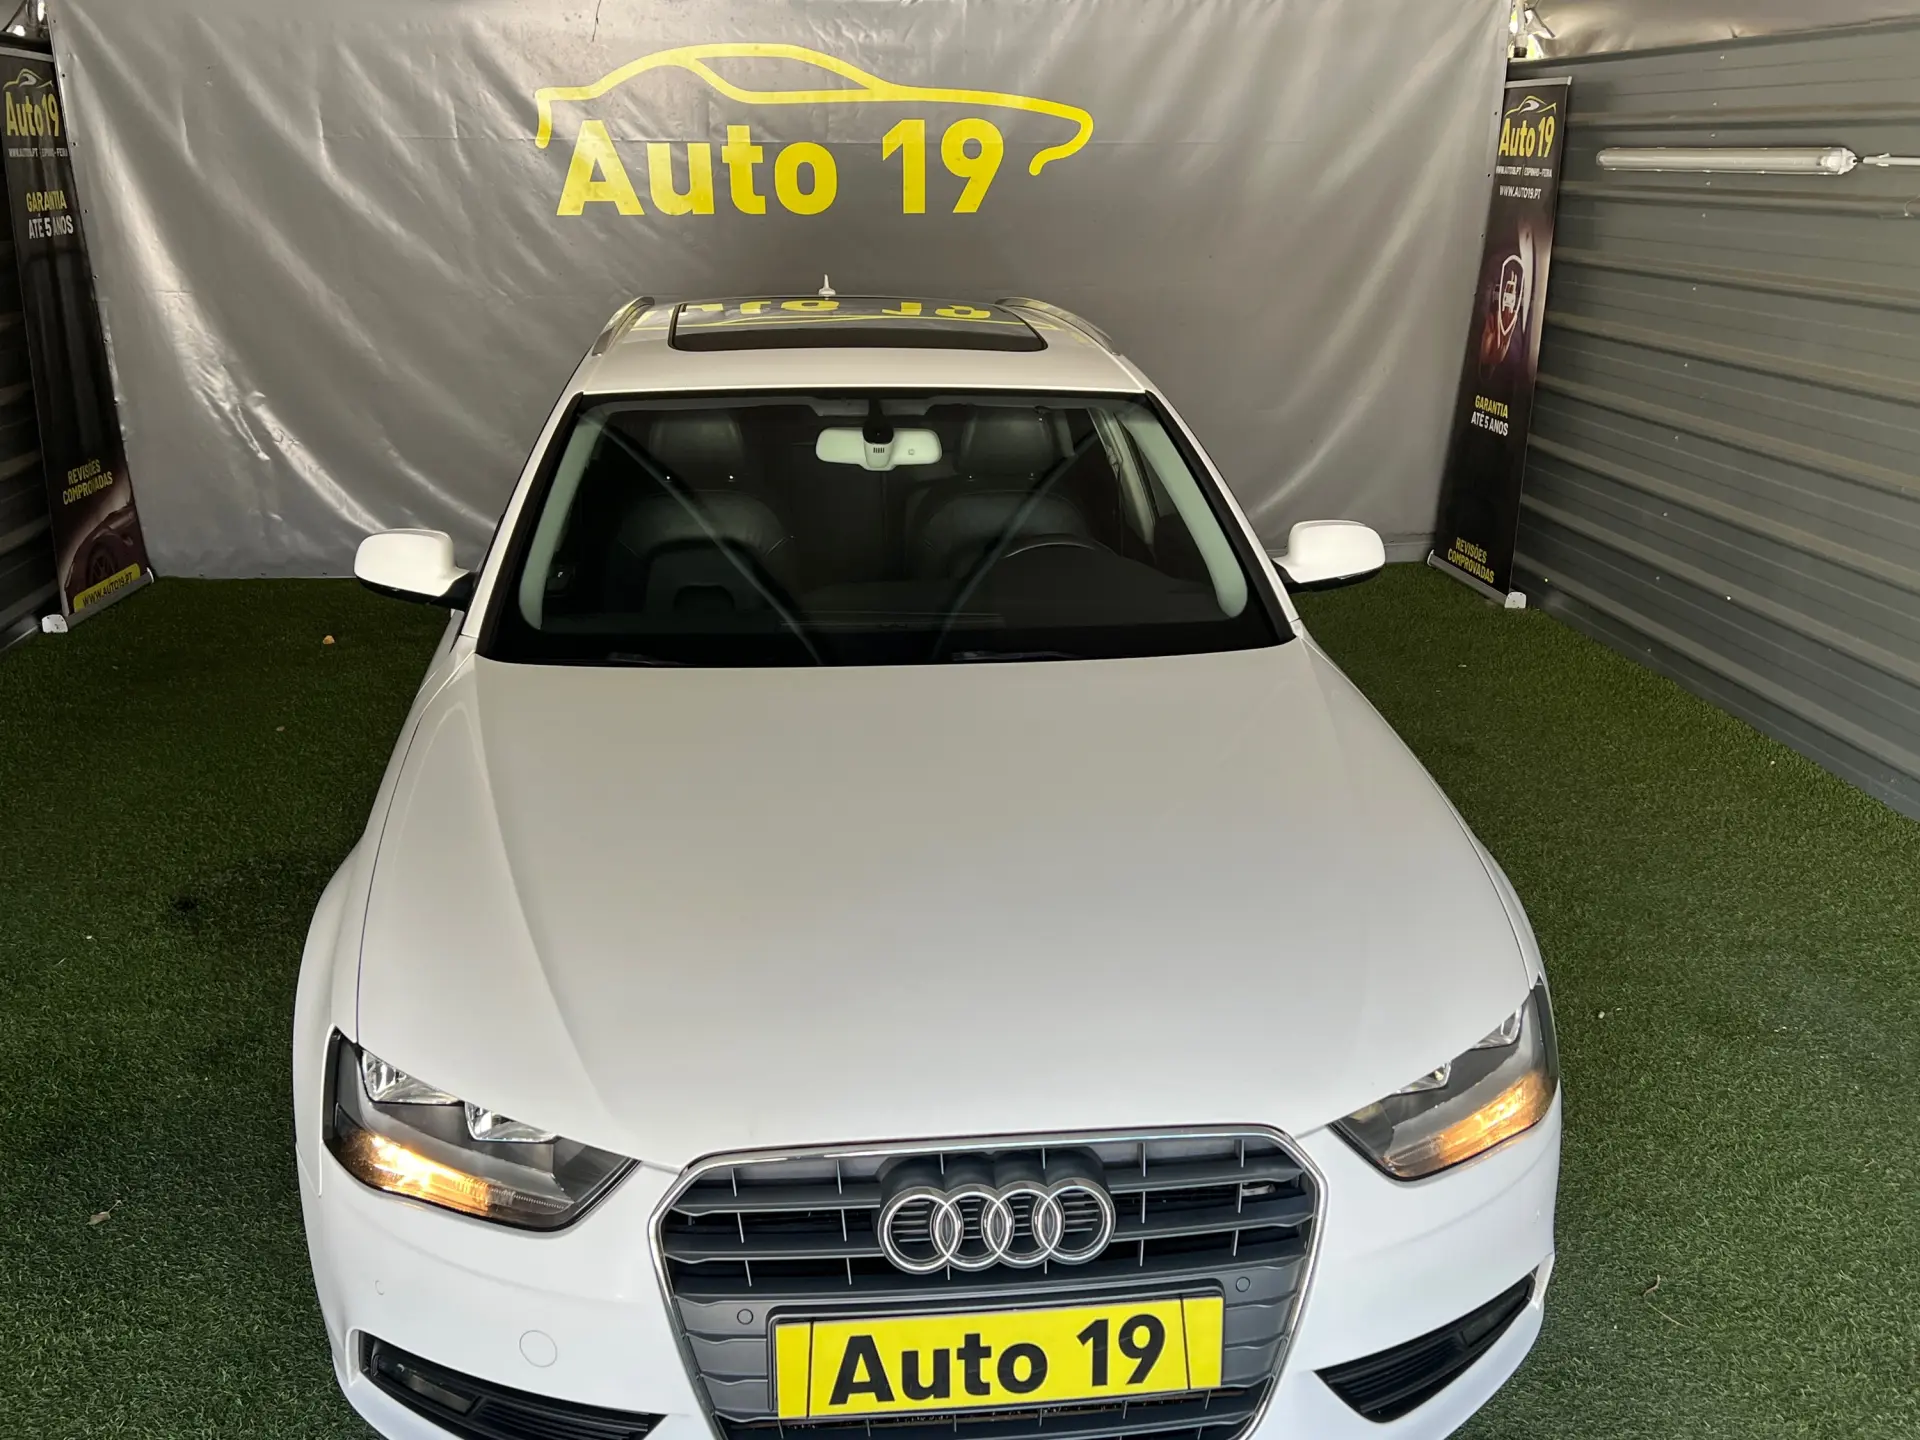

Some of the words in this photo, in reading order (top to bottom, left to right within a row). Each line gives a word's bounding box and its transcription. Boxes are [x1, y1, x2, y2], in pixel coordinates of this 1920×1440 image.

[6, 91, 43, 137] Auto
[41, 92, 60, 137] 19
[1498, 118, 1536, 157] Auto
[1537, 116, 1555, 157] 19
[556, 118, 839, 216] Auto
[881, 117, 1005, 214] 19
[26, 190, 67, 212] GARANTIA
[28, 213, 44, 239] ATÉ
[44, 217, 52, 237] 5
[52, 215, 73, 236] ANOS
[1474, 394, 1509, 419] GARANTIA
[1471, 411, 1485, 428] ATÉ
[1484, 415, 1490, 429] 5
[1489, 417, 1509, 437] ANOS
[62, 471, 113, 505] COMPROVADAS
[67, 459, 101, 485] REVISÕES
[1447, 548, 1495, 584] COMPROVADAS
[1455, 536, 1488, 564] REVISÕES
[82, 572, 133, 608] WWW.AUTO19.PT
[827, 1332, 1050, 1406] Auto
[1075, 1312, 1167, 1387] 19
